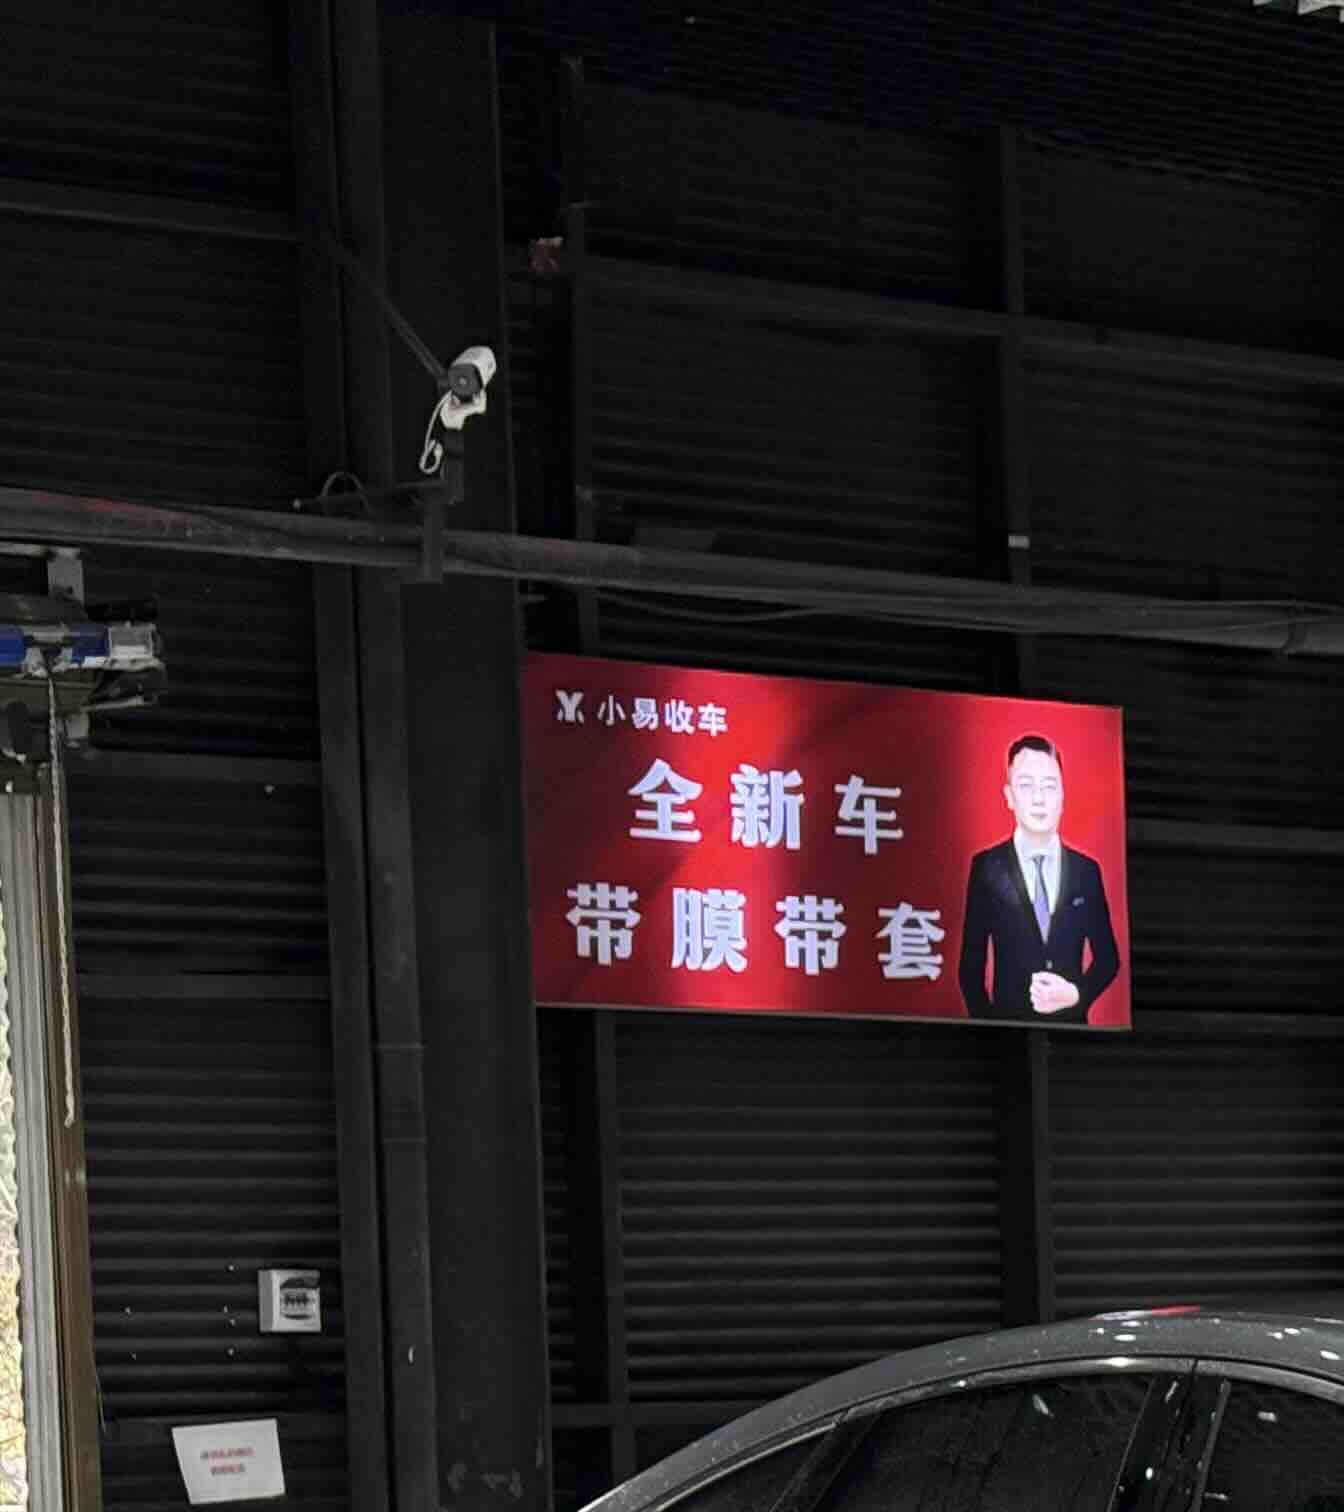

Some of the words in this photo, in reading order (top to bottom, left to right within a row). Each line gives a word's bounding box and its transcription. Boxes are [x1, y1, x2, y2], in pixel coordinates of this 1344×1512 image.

[597, 695, 728, 737] 小易收车
[628, 758, 904, 854] 全新车
[566, 882, 946, 981] 带膜带套
